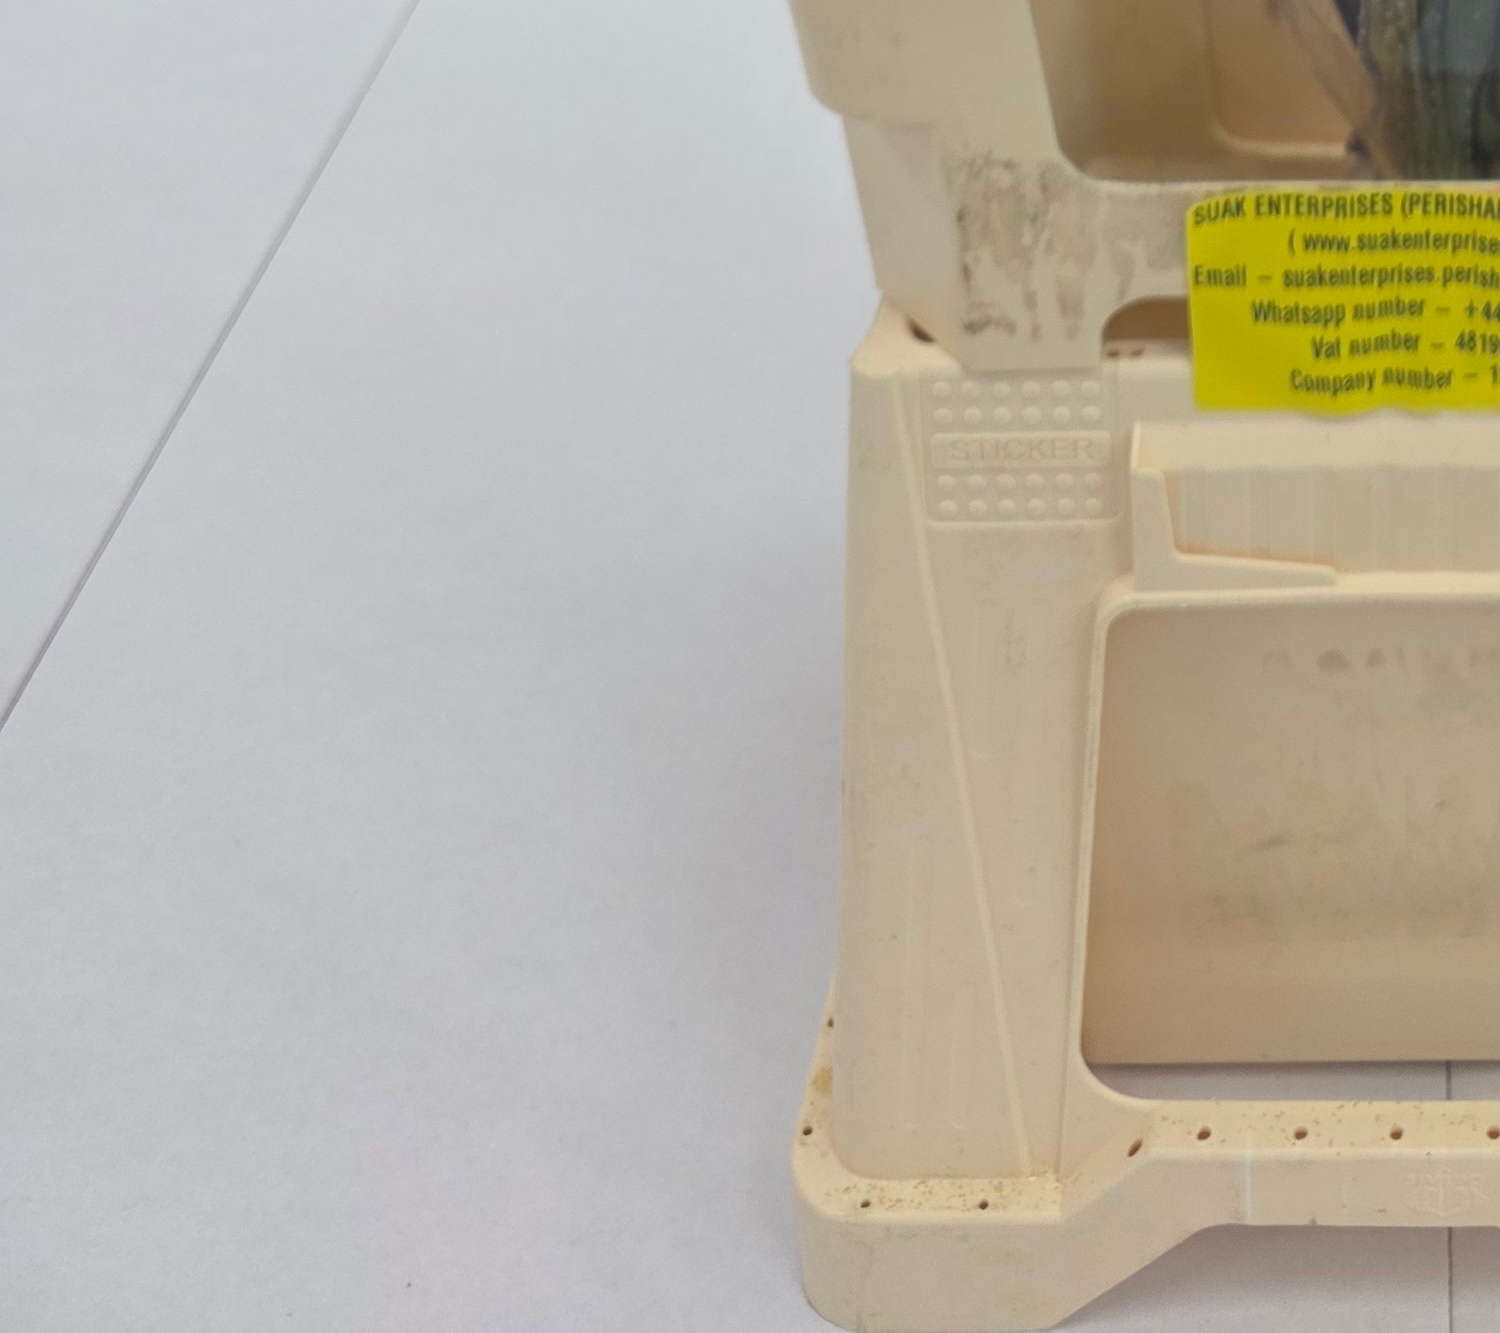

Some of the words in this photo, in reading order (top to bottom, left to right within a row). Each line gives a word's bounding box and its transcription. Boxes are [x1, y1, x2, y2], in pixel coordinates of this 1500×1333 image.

[1194, 196, 1246, 226] SUAK
[1255, 192, 1393, 220] ENTERPRISES
[1193, 264, 1247, 288] Email
[1252, 299, 1346, 328] Whatsapp
[1352, 296, 1426, 321] number
[1311, 335, 1342, 360] Vat
[1348, 329, 1421, 358] number
[1290, 368, 1376, 397] Company
[1382, 366, 1453, 390] number
[950, 438, 1095, 462] STICKER
